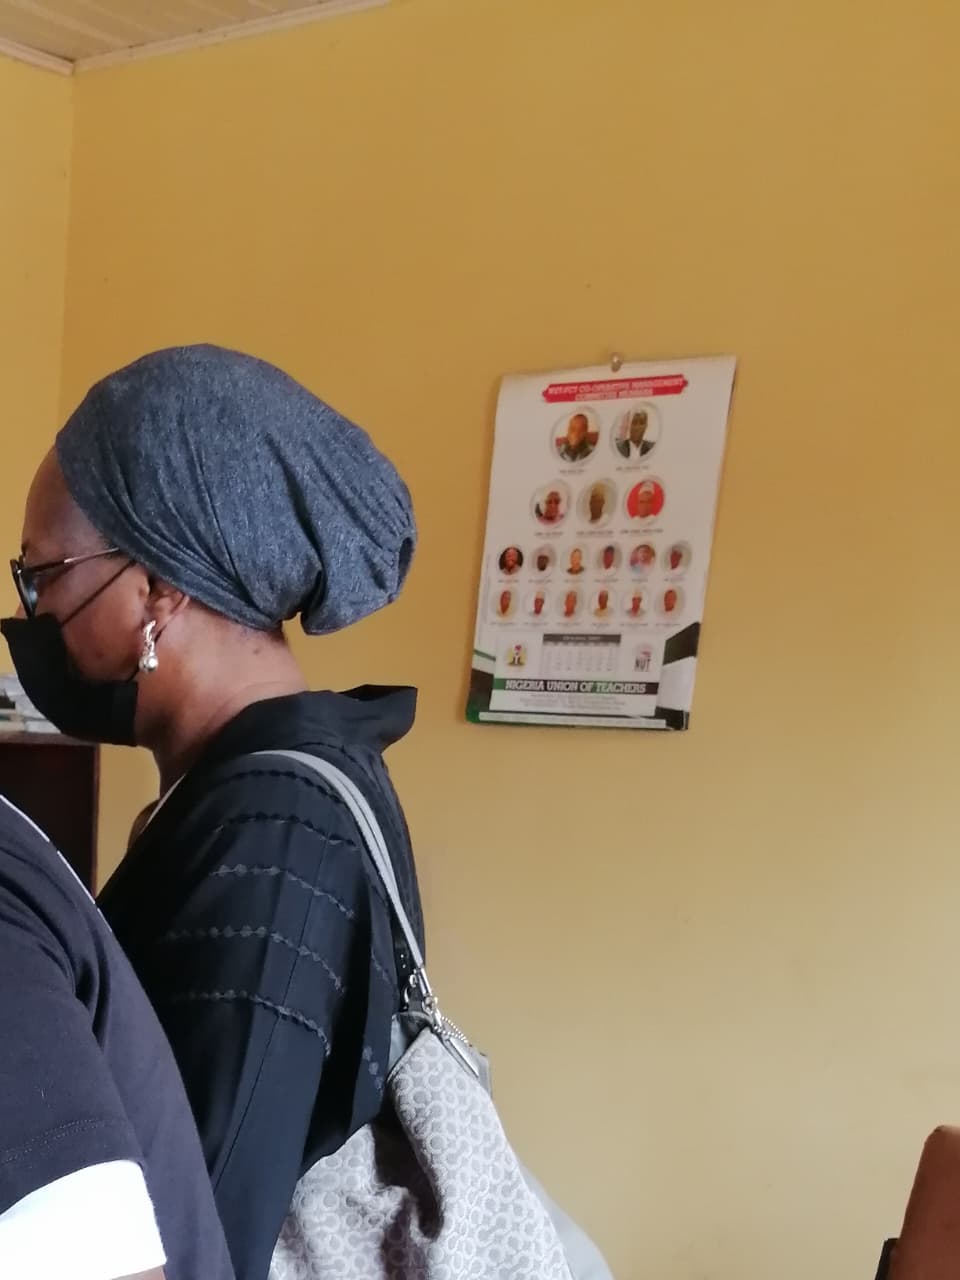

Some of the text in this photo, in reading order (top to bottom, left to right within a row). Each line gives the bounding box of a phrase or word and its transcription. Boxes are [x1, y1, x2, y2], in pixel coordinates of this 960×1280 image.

[505, 679, 646, 694] NIGERIA UNION OF TEACHERS
